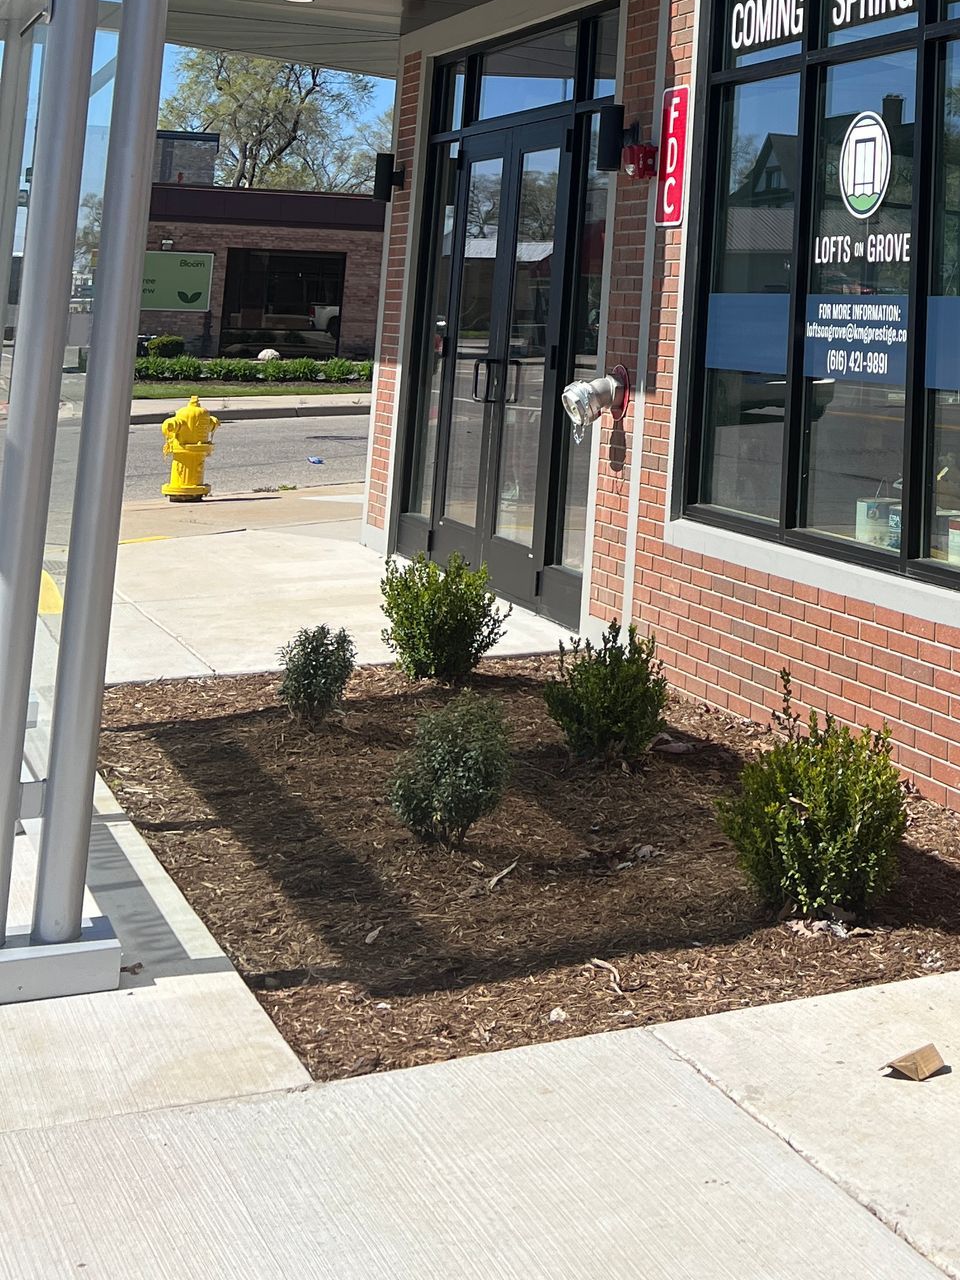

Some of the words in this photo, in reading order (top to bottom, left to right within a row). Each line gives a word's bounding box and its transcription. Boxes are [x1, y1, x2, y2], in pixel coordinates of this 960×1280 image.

[663, 96, 681, 215] FDC
[814, 235, 851, 264] LOFTS
[854, 241, 865, 257] ON
[867, 233, 911, 263] GROVE
[818, 303, 832, 319] FOR
[832, 304, 852, 320] MORE
[852, 304, 902, 322] INFORMATION:
[806, 322, 908, 345] loftsongrove@kmgprestige.co
[827, 349, 848, 375] (616)
[849, 351, 888, 375] 421-9891
